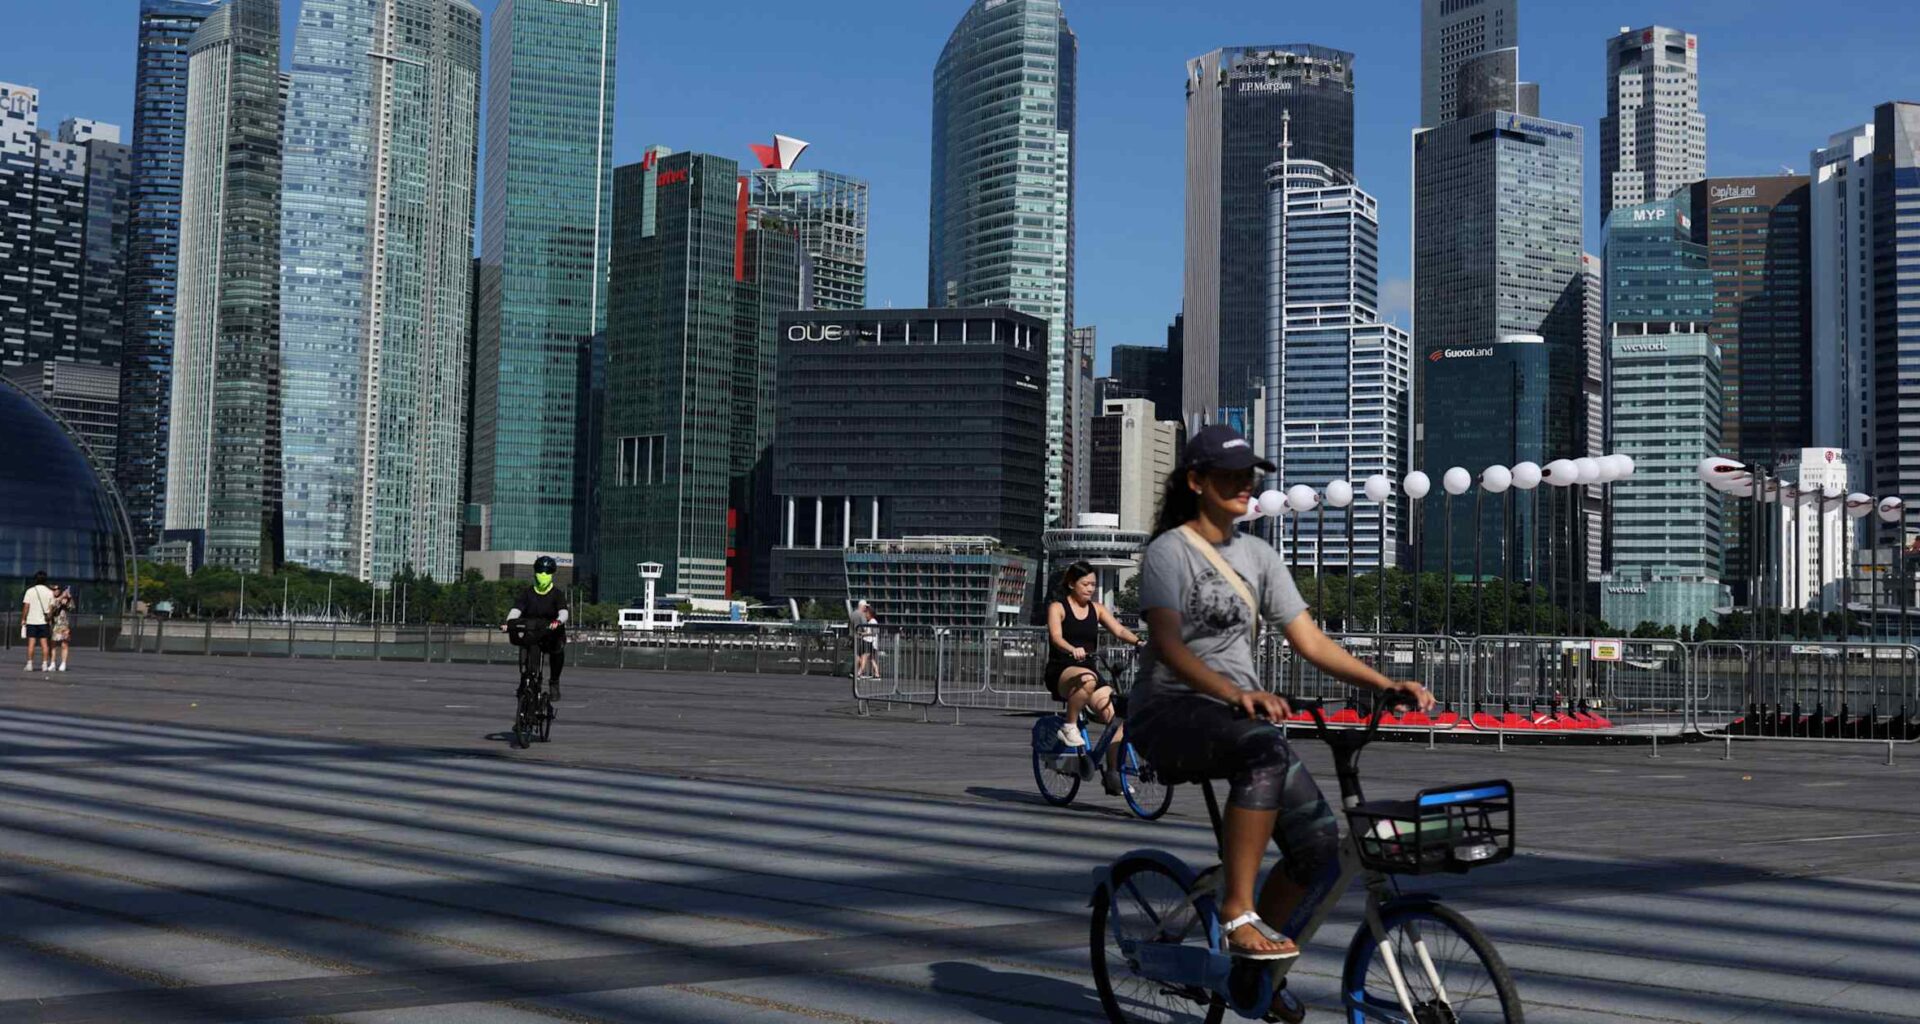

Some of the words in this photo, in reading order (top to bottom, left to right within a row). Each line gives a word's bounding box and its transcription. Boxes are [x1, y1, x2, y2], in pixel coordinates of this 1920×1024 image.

[1239, 81, 1292, 94] J.P.Morgan
[0, 96, 31, 114] citi
[1711, 184, 1756, 199] CapitaLand
[1634, 209, 1666, 221] MYP
[788, 325, 842, 341] OUE
[1621, 339, 1669, 352] wework
[1608, 583, 1647, 594] wework
